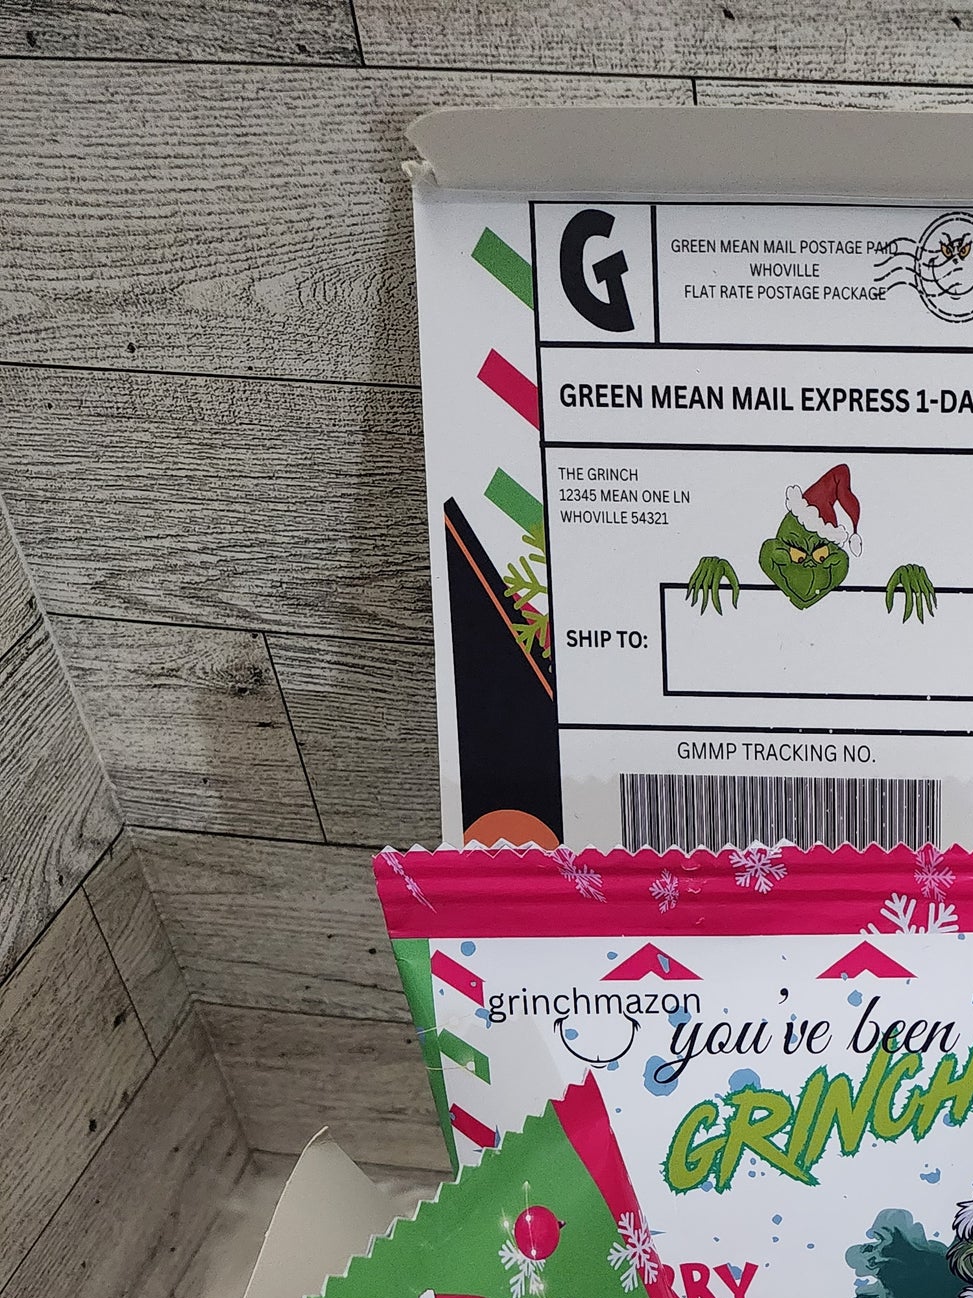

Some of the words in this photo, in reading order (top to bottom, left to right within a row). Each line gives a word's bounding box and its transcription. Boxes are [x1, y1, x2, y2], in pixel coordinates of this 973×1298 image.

[671, 238, 717, 255] GREEN
[720, 238, 759, 255] MEAN
[763, 239, 797, 255] MAIL
[799, 239, 863, 257] POSTAGE
[867, 241, 899, 257] PAID
[559, 208, 635, 333] G
[749, 263, 820, 278] WHOVILLE
[684, 285, 716, 300] FLAT
[720, 286, 753, 300] RATE
[757, 286, 819, 301] POSTAGE
[823, 286, 887, 302] PACKAGE
[559, 383, 643, 409] GREEN
[652, 384, 725, 411] MEAN
[733, 385, 794, 411] MAIL
[801, 386, 910, 413] EXPRESS
[558, 467, 585, 481] THE
[589, 467, 639, 482] GRINCH
[559, 488, 597, 502] 12345
[600, 488, 637, 503] MEAN
[641, 489, 669, 503] ONE
[673, 489, 690, 503] LN
[560, 510, 629, 525] WHOVILLE
[632, 511, 669, 526] 54321
[566, 630, 612, 649] SHIP
[616, 631, 649, 650] TO:
[677, 742, 737, 761] GMMP
[741, 743, 838, 763] TRACKING
[842, 744, 877, 764] NO.
[487, 988, 702, 1024] grinchmazon
[653, 987, 833, 1084] you've
[846, 996, 968, 1054] been
